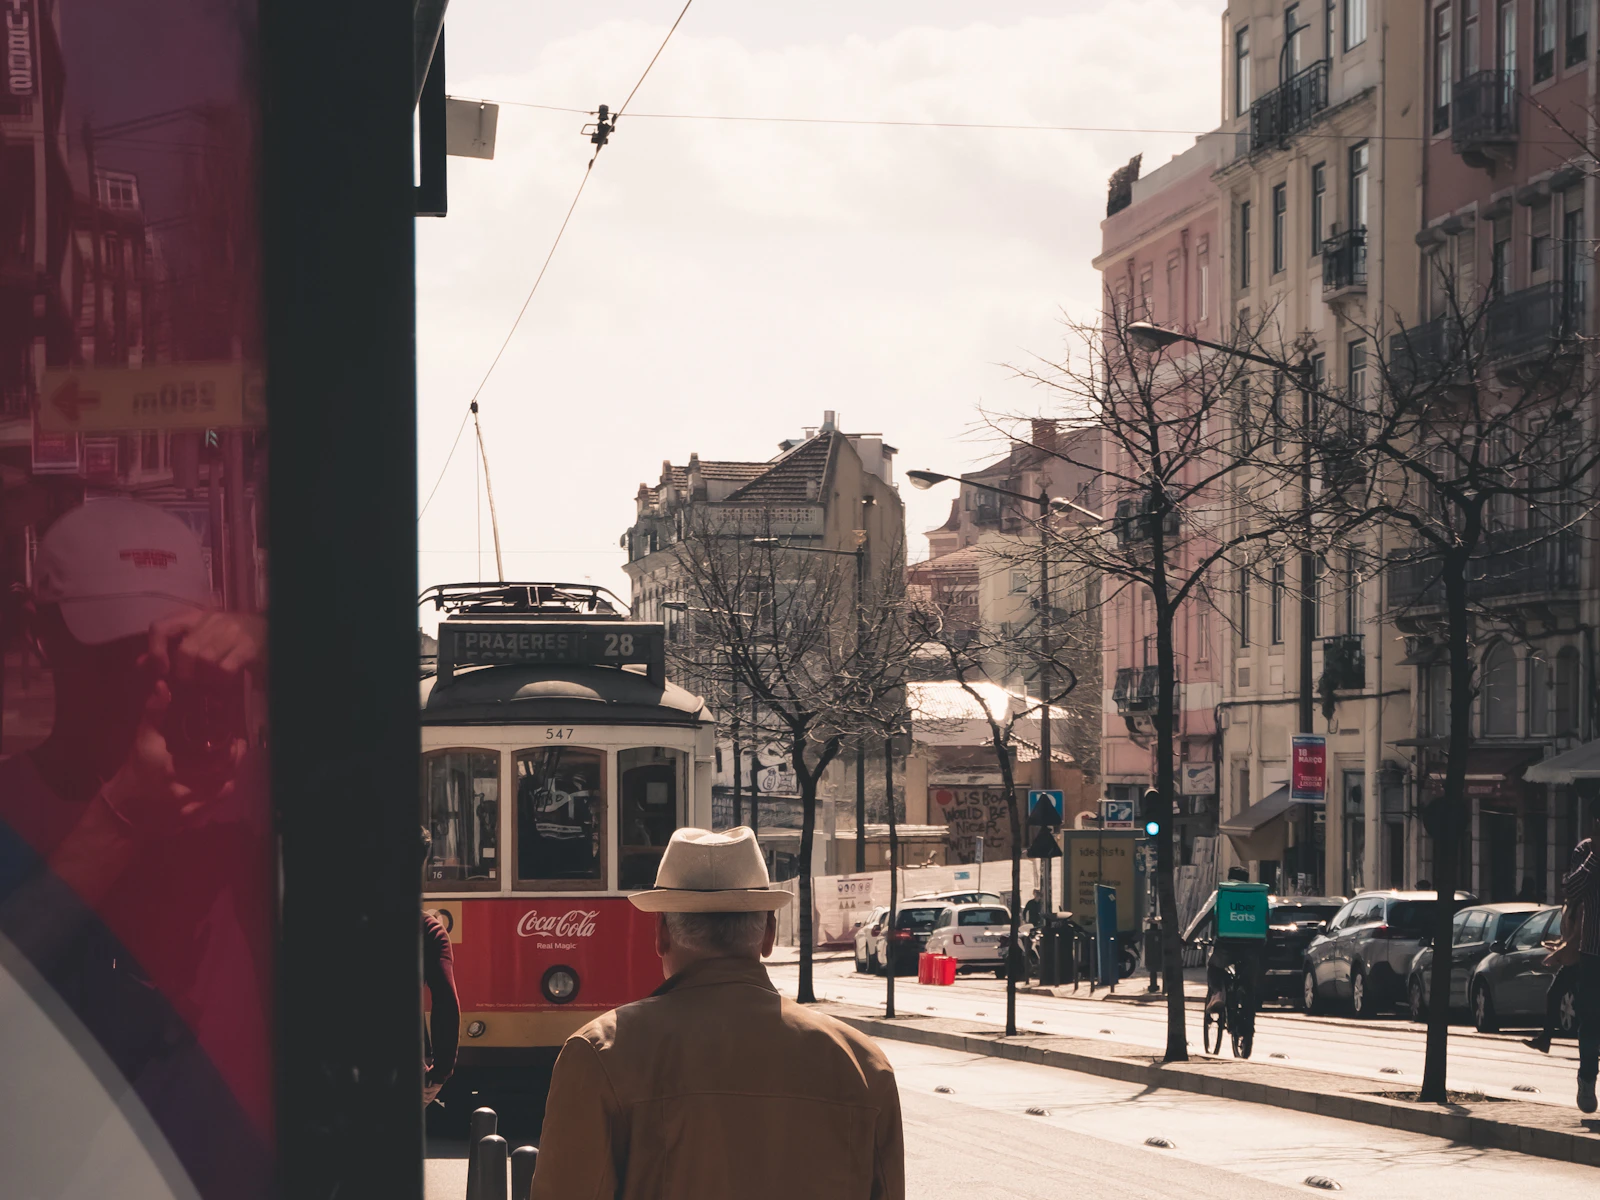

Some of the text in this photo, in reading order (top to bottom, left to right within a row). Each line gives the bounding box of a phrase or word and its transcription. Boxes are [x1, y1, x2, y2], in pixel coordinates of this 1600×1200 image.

[465, 633, 635, 657] PRAZERES 28
[546, 728, 574, 740] 547
[1108, 803, 1118, 817] P
[432, 871, 442, 879] 16
[1230, 902, 1255, 911] Uber
[1230, 911, 1256, 922] Eats
[517, 910, 600, 938] Coca-Cola
[554, 942, 577, 951] Magic
